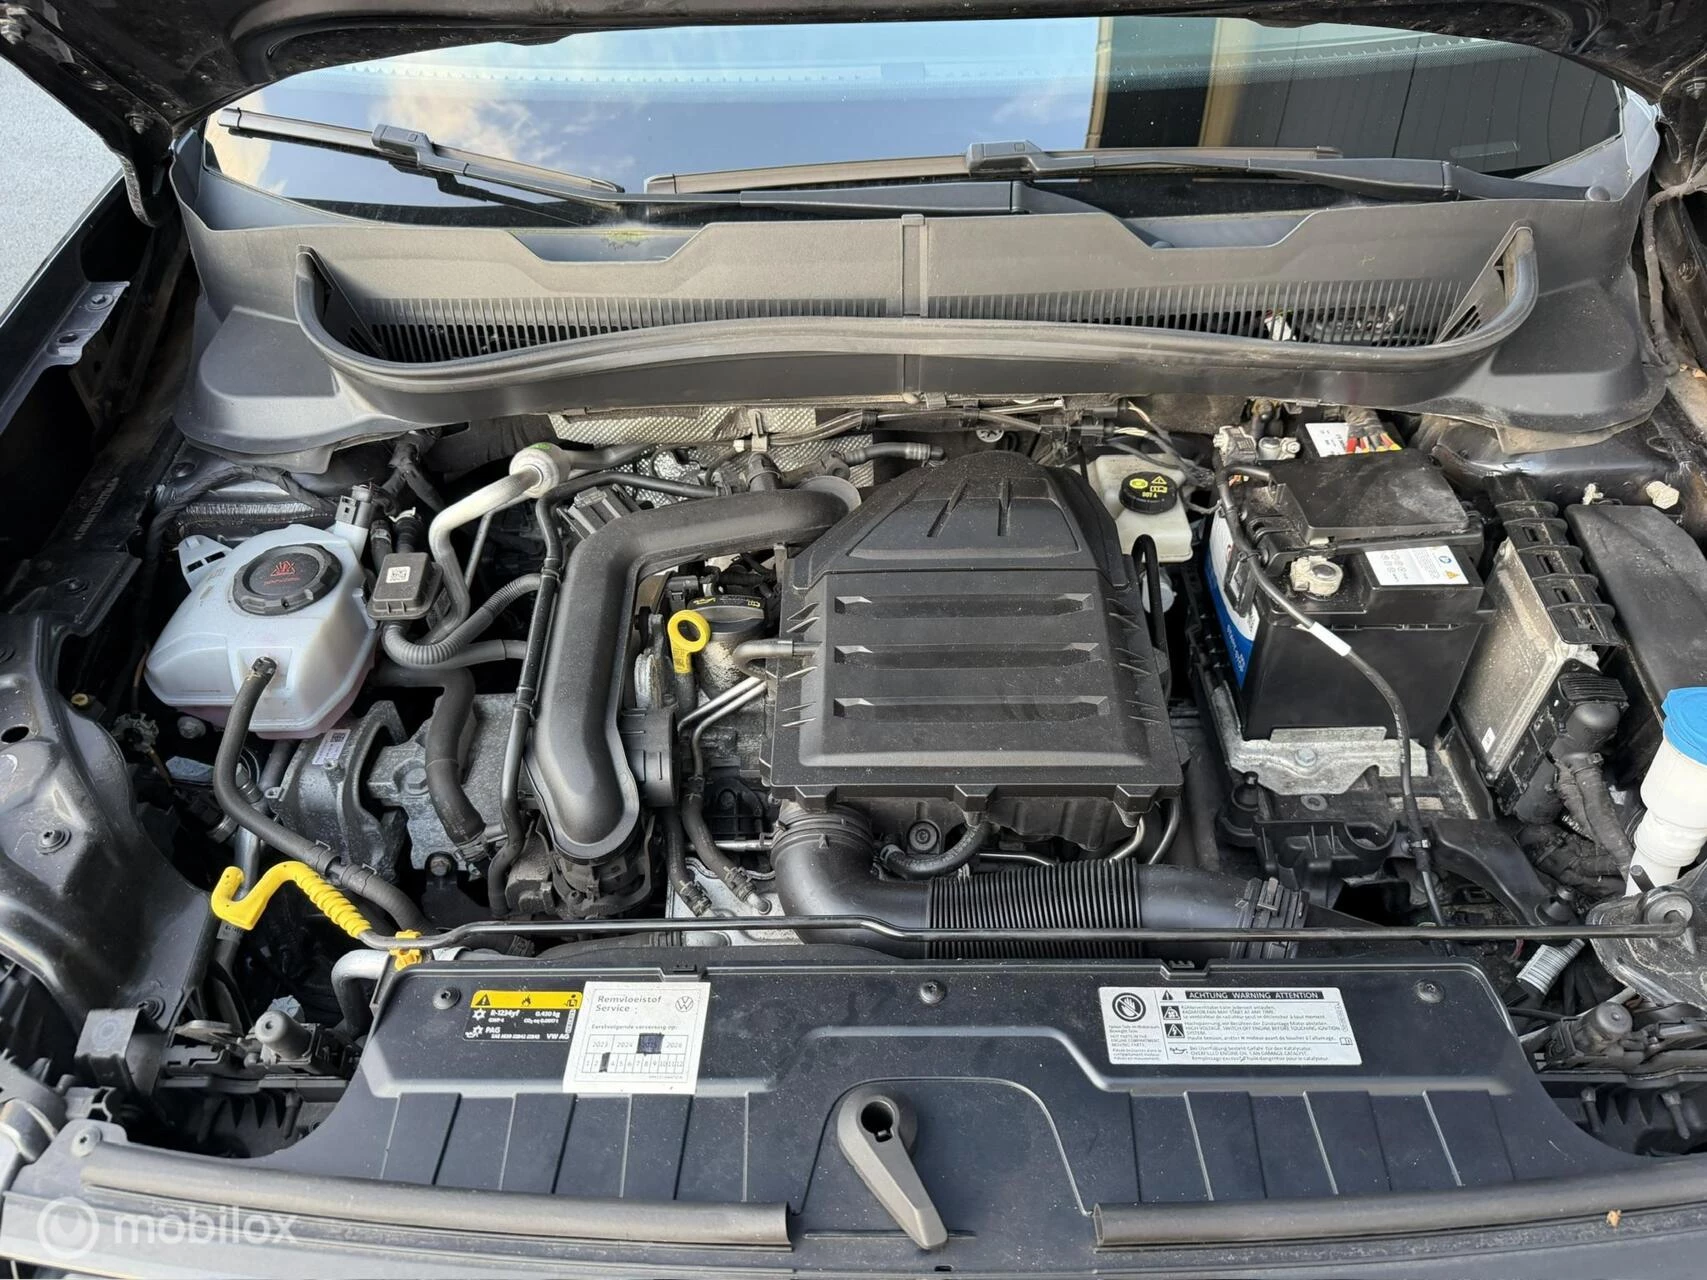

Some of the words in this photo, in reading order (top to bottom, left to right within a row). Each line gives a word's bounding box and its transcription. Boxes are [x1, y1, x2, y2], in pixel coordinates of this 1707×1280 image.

[1189, 991, 1228, 999] ACHTUNG
[1232, 991, 1271, 999] WARNING
[1275, 991, 1318, 999] ATTENTION
[597, 995, 663, 1004] Remvloeistof
[595, 1004, 630, 1012] Service
[485, 1026, 501, 1034] PAG
